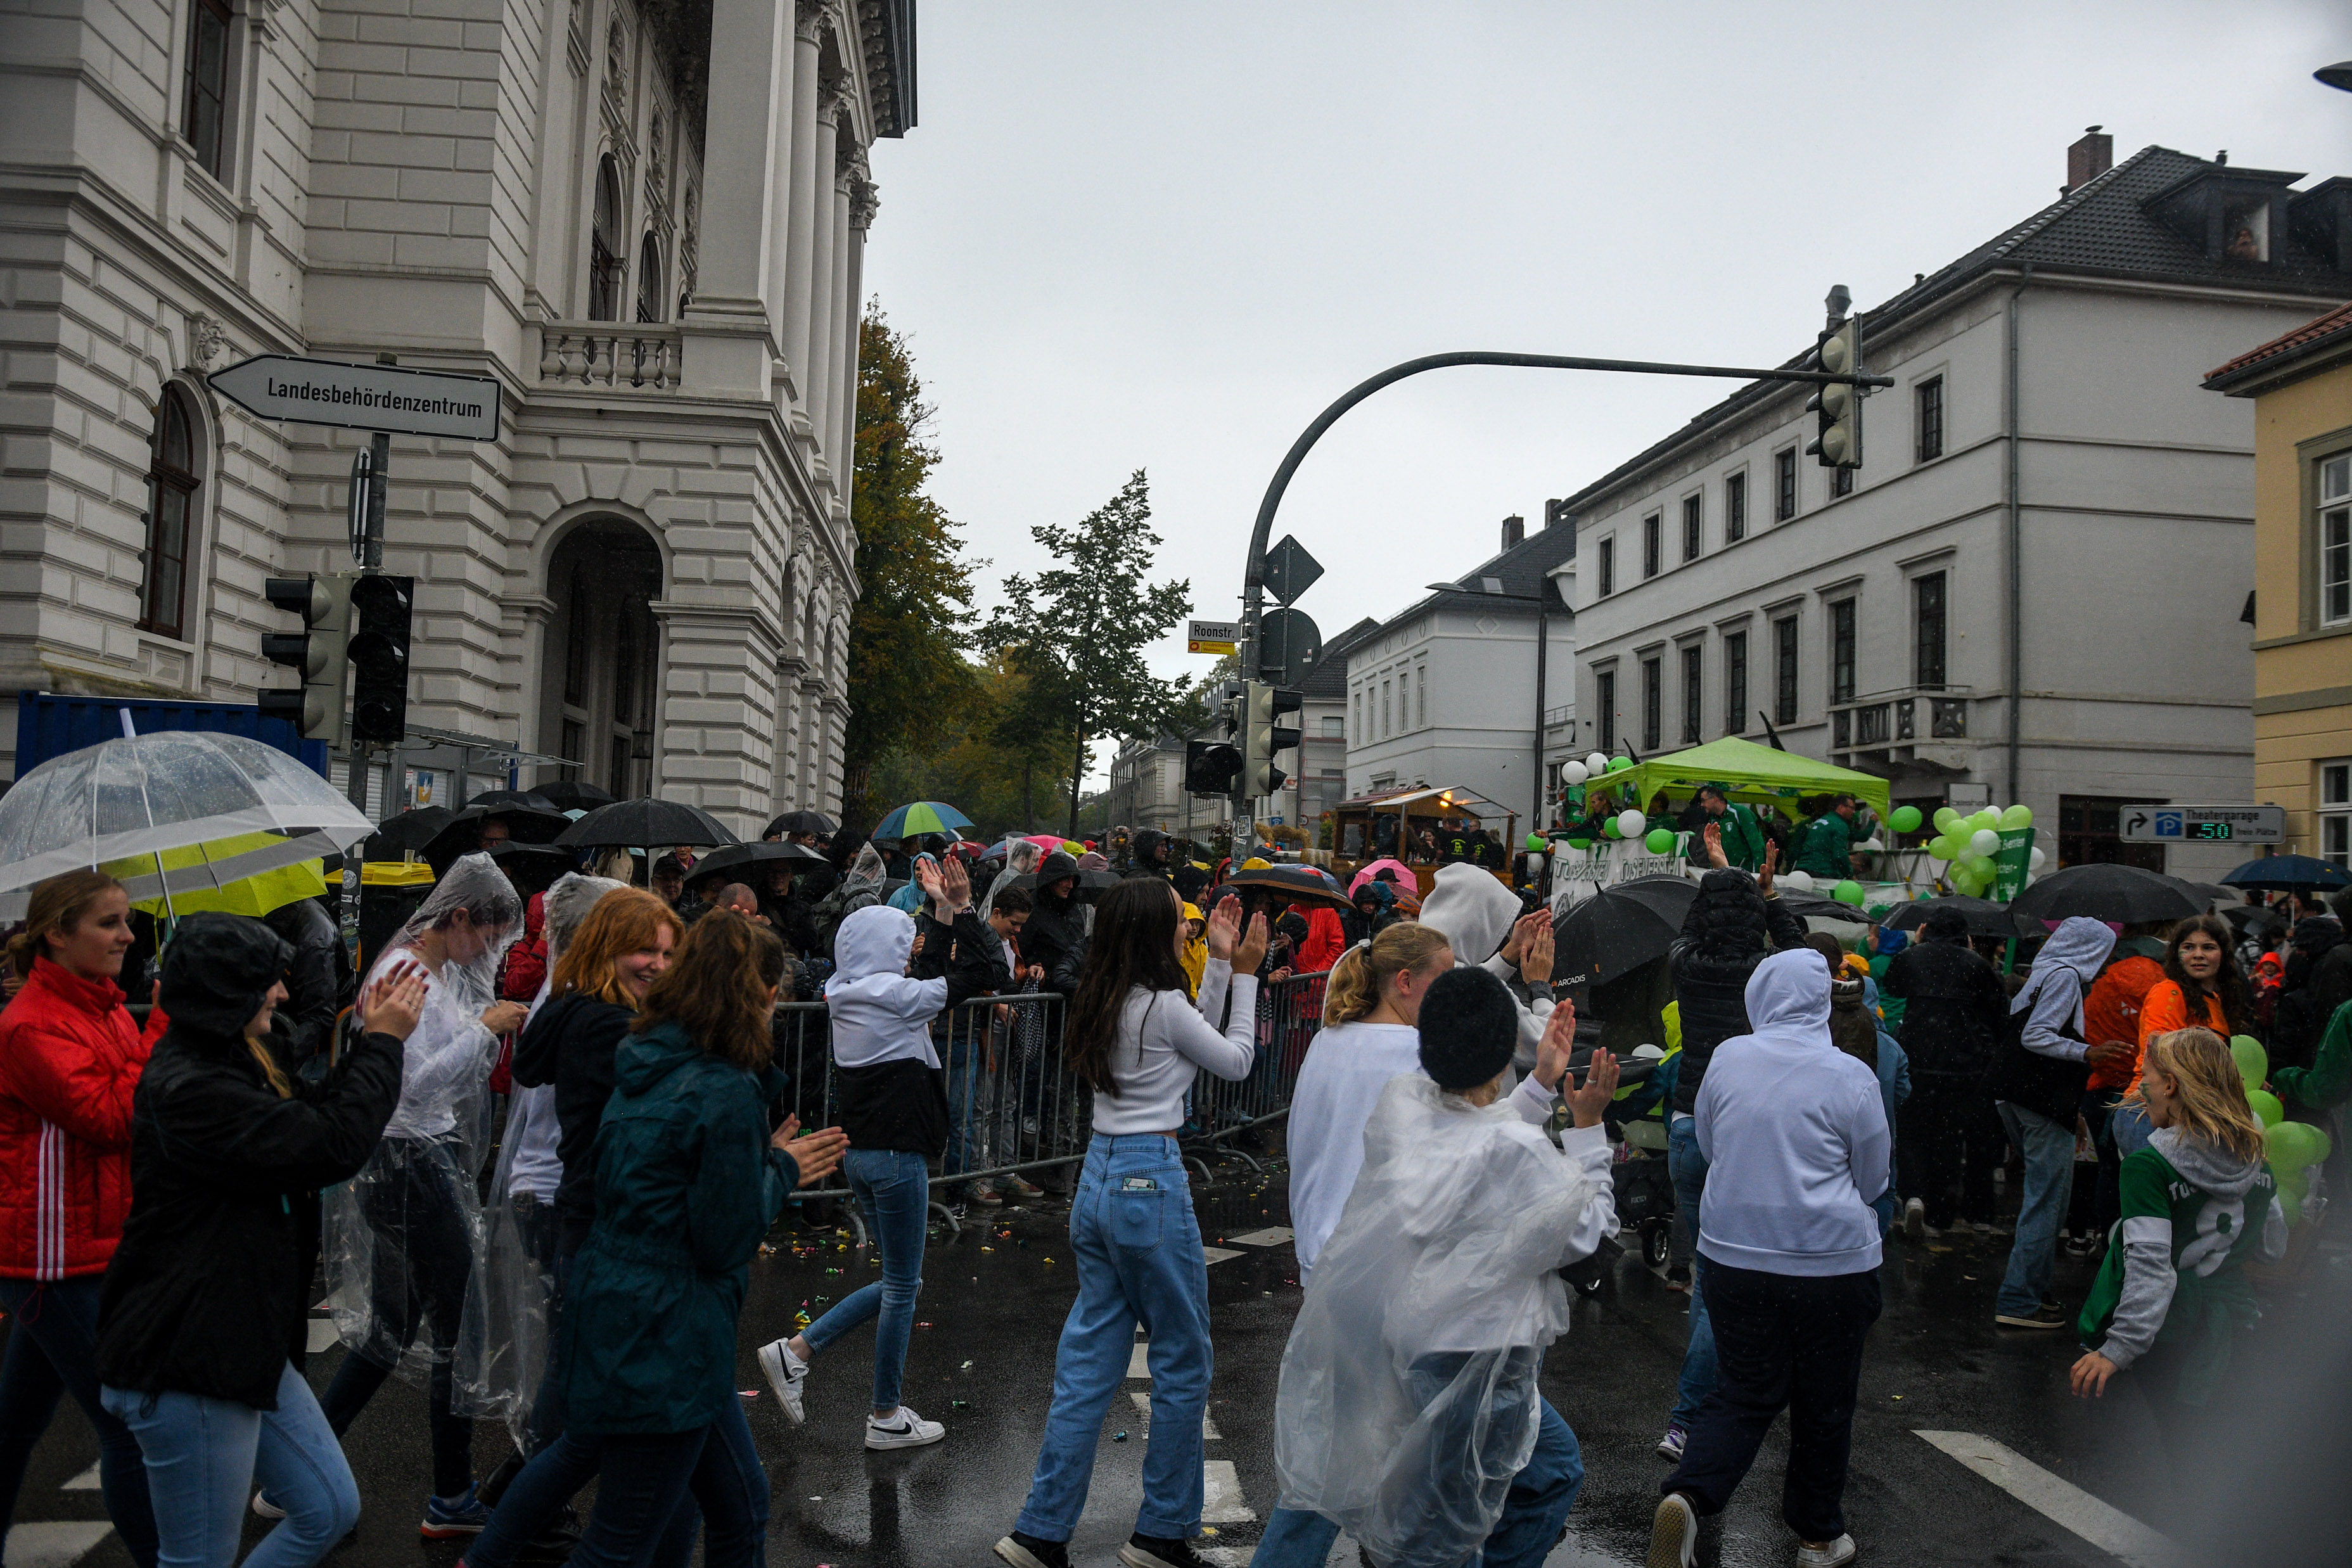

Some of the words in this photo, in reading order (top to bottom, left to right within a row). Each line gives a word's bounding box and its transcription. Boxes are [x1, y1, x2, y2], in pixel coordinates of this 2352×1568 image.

[267, 377, 482, 418] Landesbehördenzentrum
[1194, 625, 1235, 639] Roonstr.
[2186, 809, 2259, 822] Theatergarage
[2201, 823, 2229, 839] 50
[1557, 974, 1586, 988] ARCADIS
